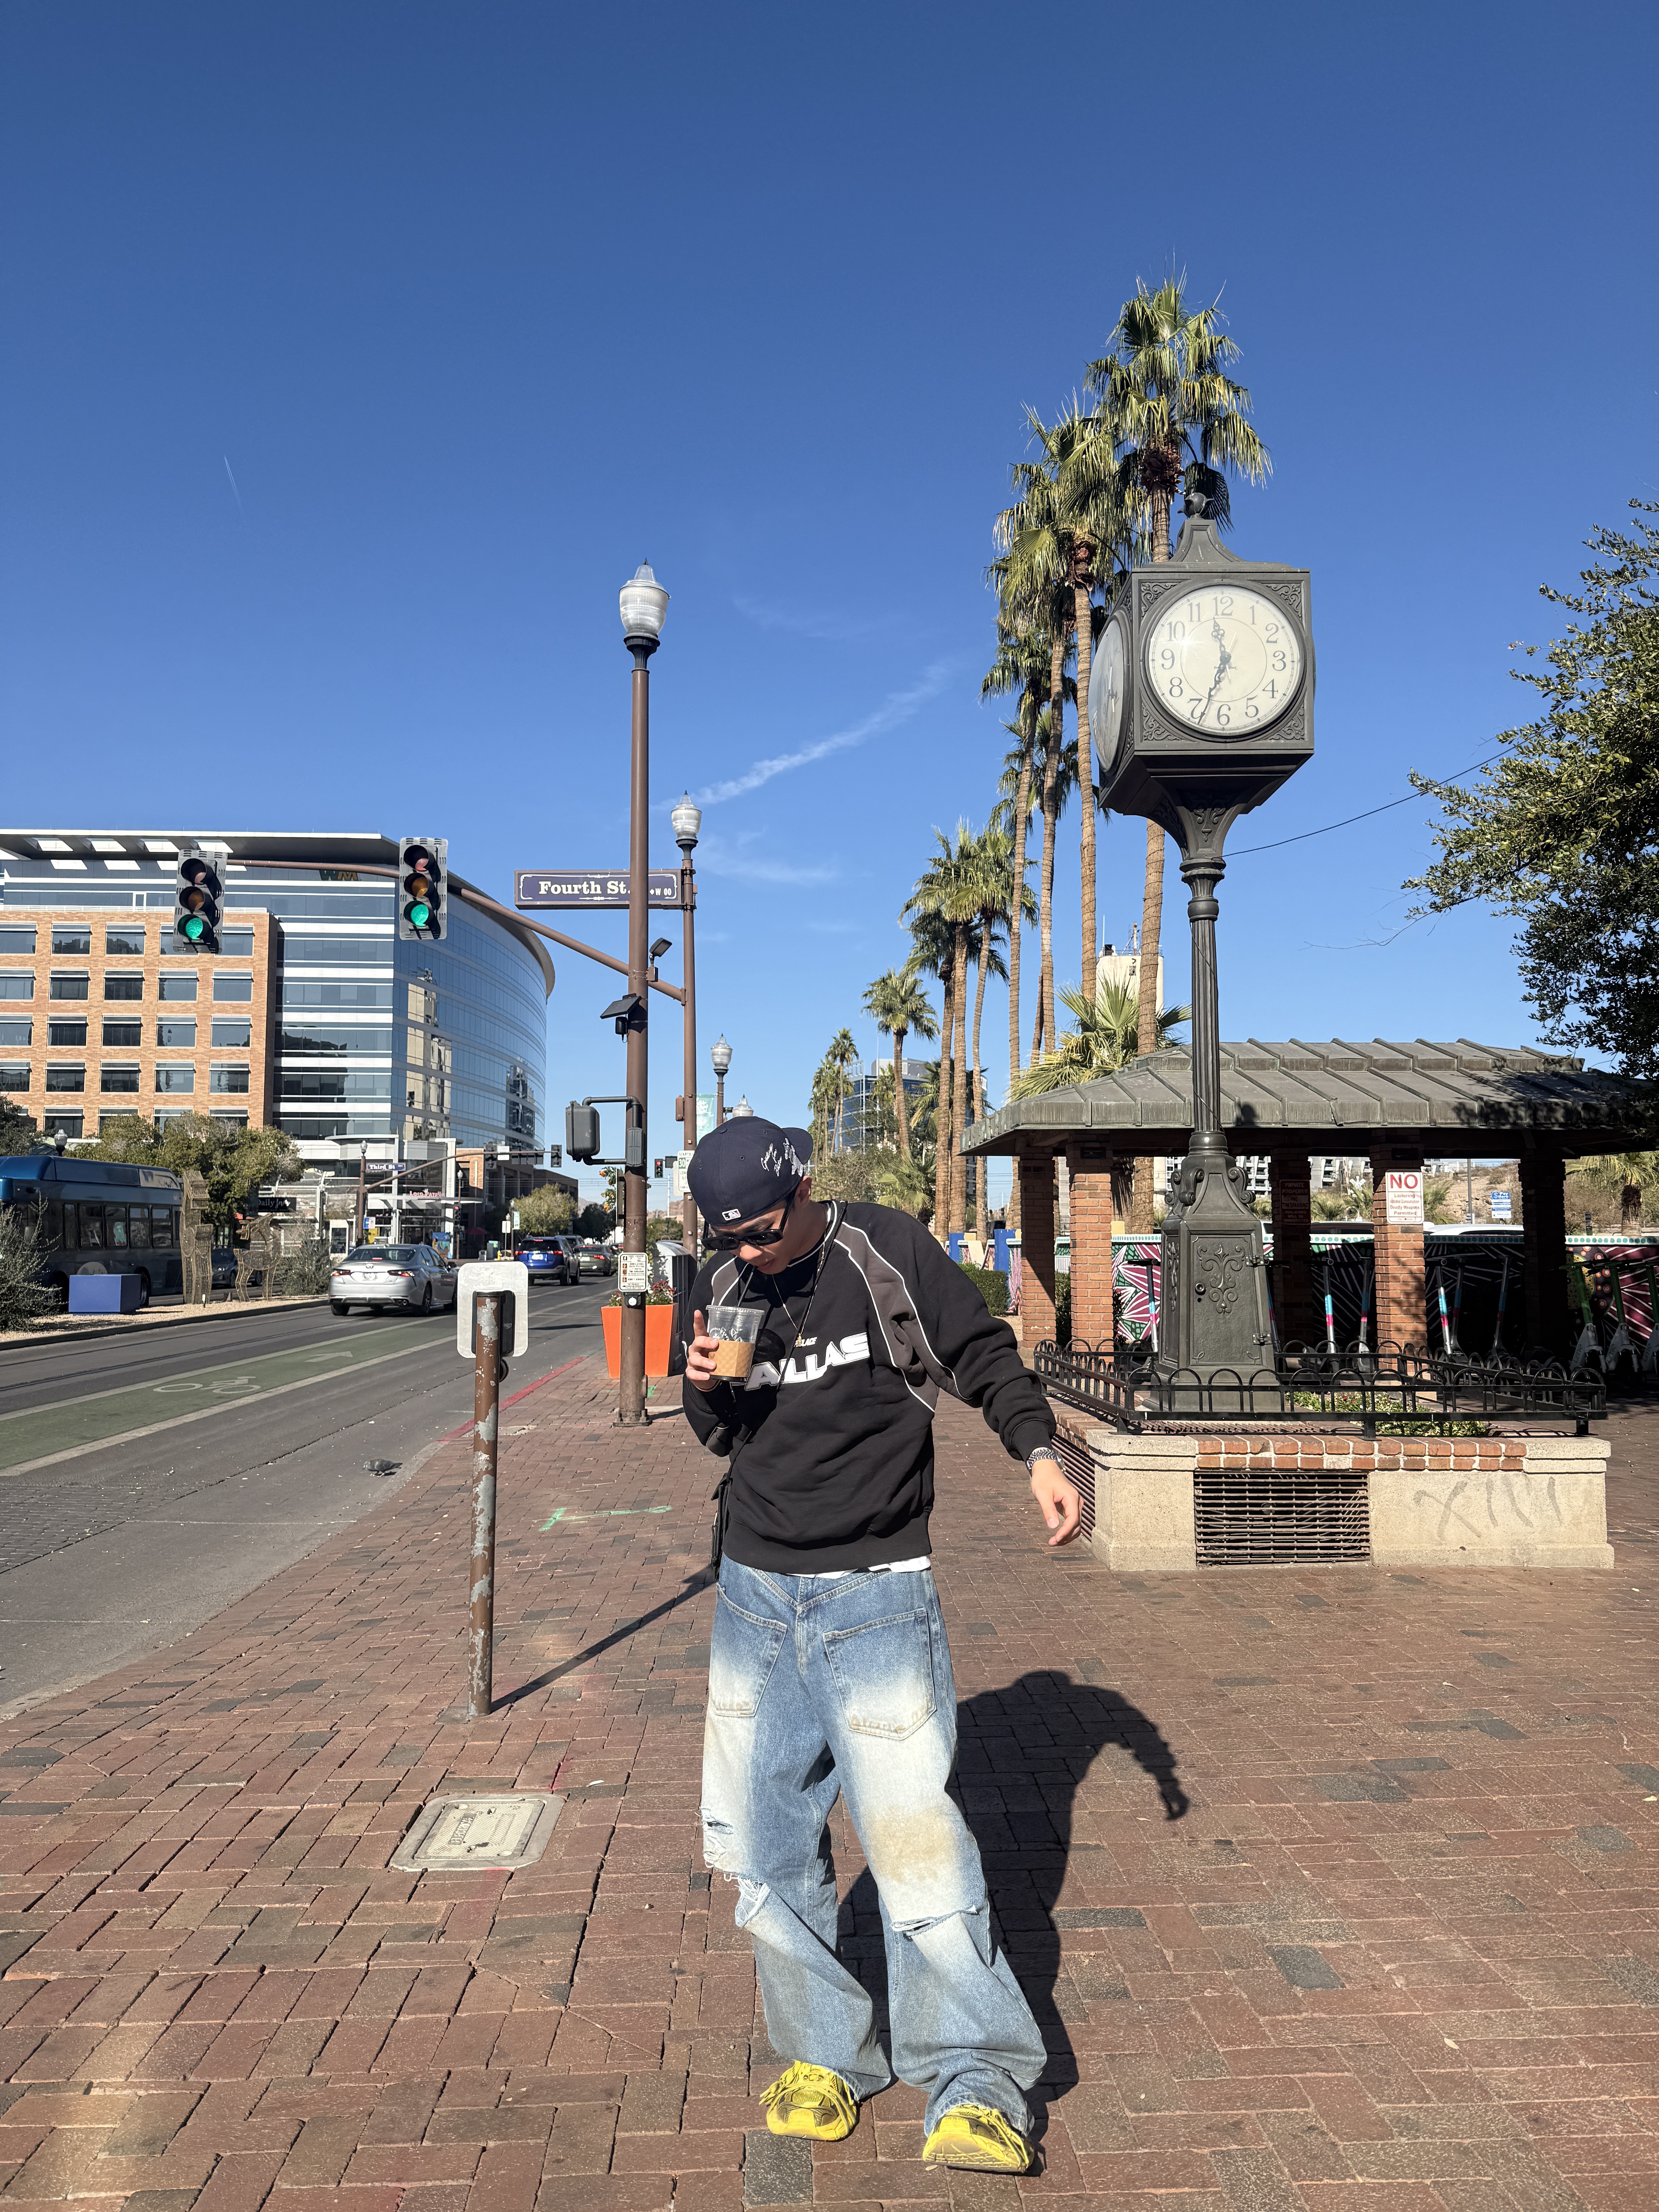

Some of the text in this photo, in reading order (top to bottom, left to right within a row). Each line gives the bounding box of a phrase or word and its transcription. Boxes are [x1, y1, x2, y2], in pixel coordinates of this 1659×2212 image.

[1188, 602, 1202, 622] 11
[1213, 596, 1233, 616] 12
[1250, 605, 1256, 625] 1
[1167, 621, 1185, 641] 10
[1266, 623, 1278, 643] 2
[1161, 648, 1175, 669] 9
[1272, 650, 1286, 671] 3
[1169, 677, 1183, 697] 8
[1262, 678, 1278, 698] 4
[1187, 698, 1203, 719] 7
[1217, 704, 1231, 725] 6
[1245, 695, 1259, 718] 5
[539, 881, 602, 895] Fourth
[679, 1158, 686, 1168] 30
[1390, 1174, 1418, 1189] NO
[731, 1332, 871, 1391] ALLAS
